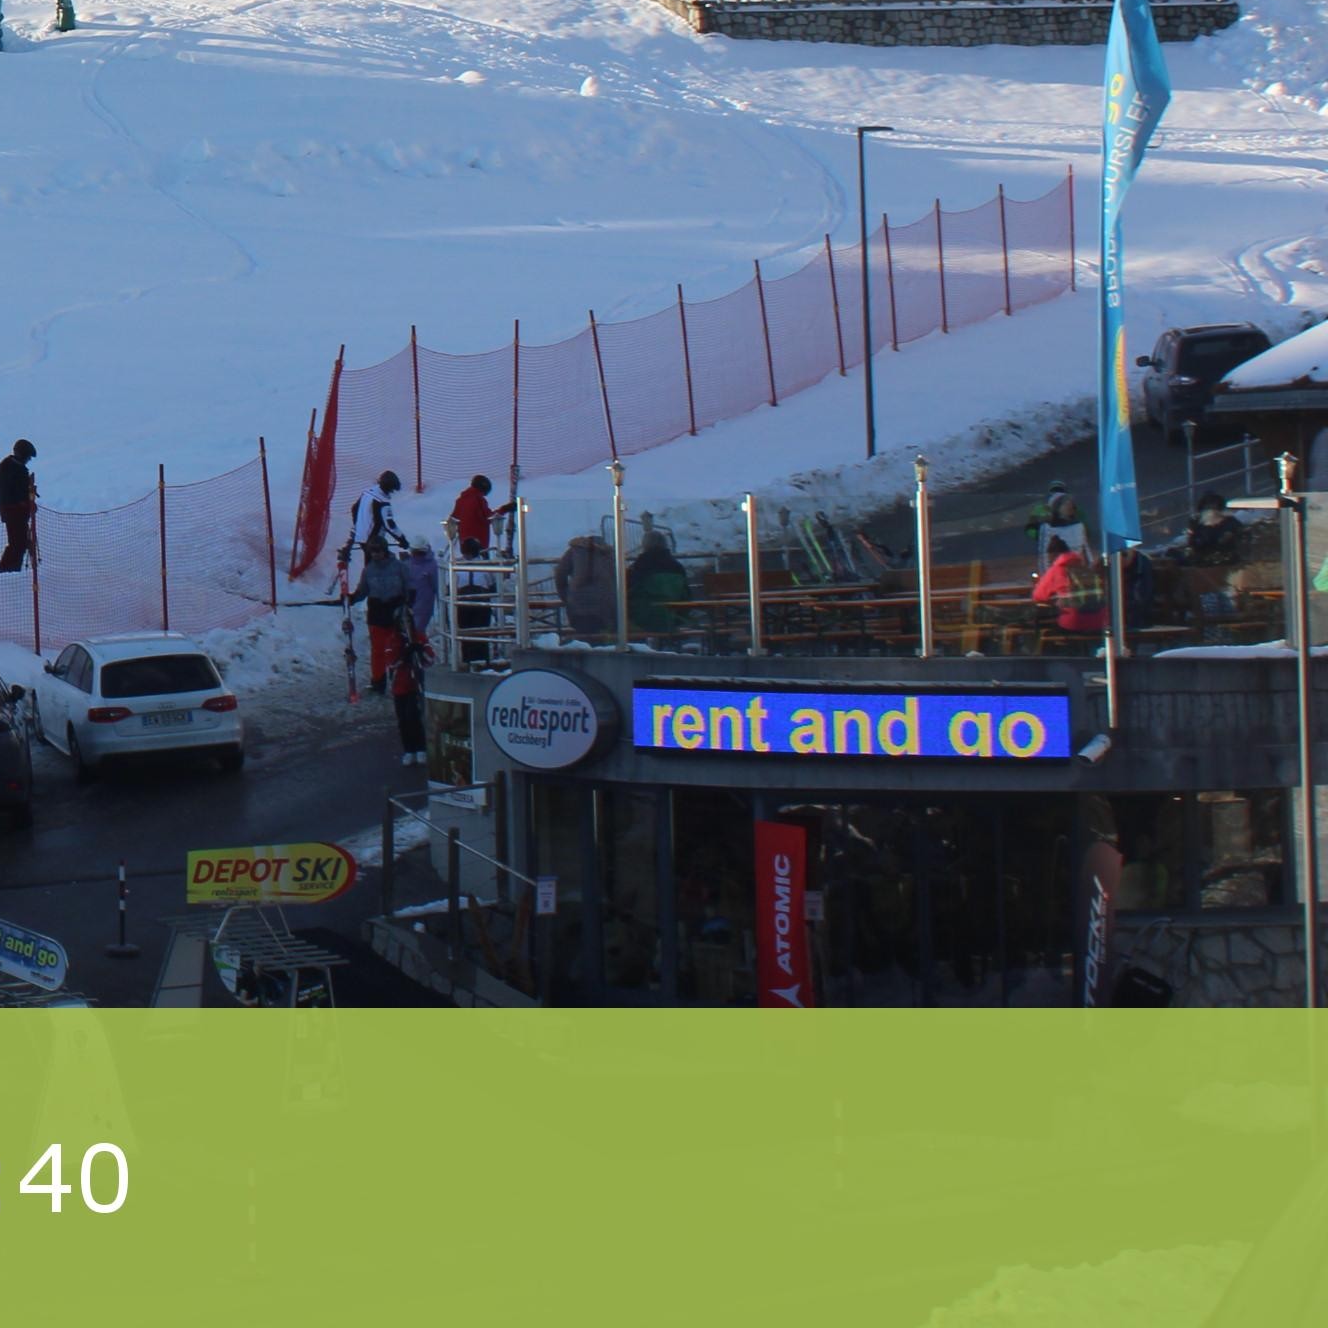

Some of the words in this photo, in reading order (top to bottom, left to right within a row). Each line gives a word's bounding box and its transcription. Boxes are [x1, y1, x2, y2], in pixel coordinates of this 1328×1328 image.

[491, 695, 590, 747] rentasport
[507, 732, 547, 749] Gitschberg
[652, 696, 771, 752] rent
[788, 696, 920, 756] and
[192, 858, 290, 884] DEPOT
[291, 856, 343, 882] SKI
[774, 853, 794, 977] ATOMIC
[5, 936, 35, 958] and
[37, 948, 58, 967] go
